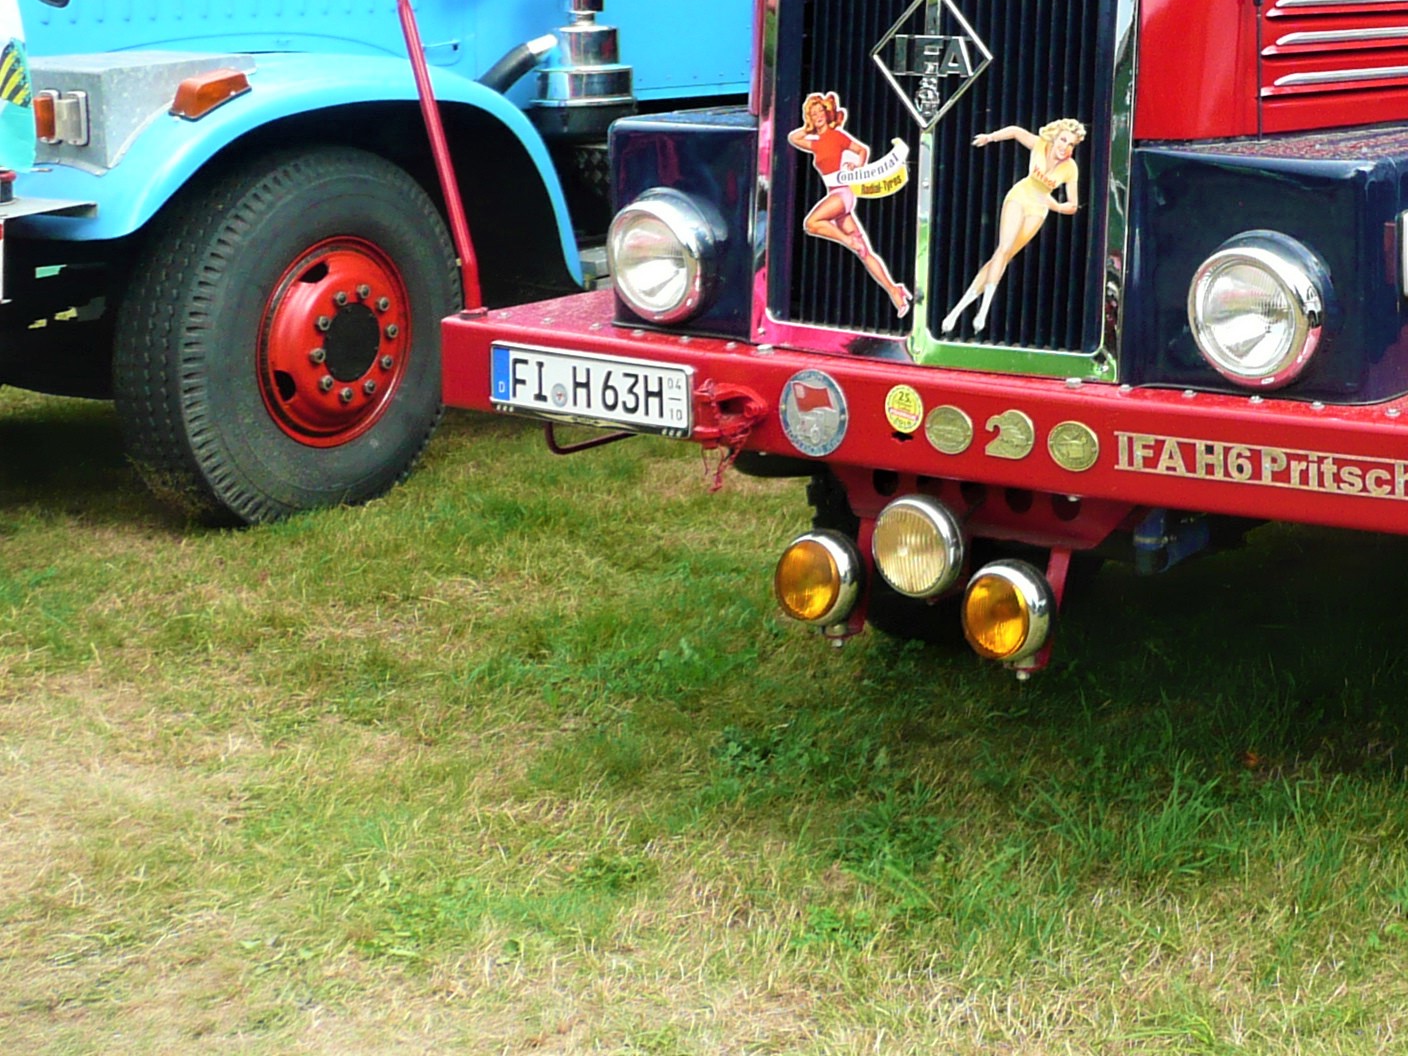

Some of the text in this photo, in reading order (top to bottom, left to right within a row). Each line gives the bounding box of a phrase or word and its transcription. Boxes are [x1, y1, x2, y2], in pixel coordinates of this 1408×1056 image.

[893, 34, 975, 77] IFA
[836, 152, 900, 184] Continental
[499, 381, 506, 393] D
[512, 357, 664, 418] FI H 63H
[667, 376, 682, 391] 04
[669, 408, 683, 422] 10
[1117, 433, 1187, 477] IFA
[1195, 440, 1252, 481] H6
